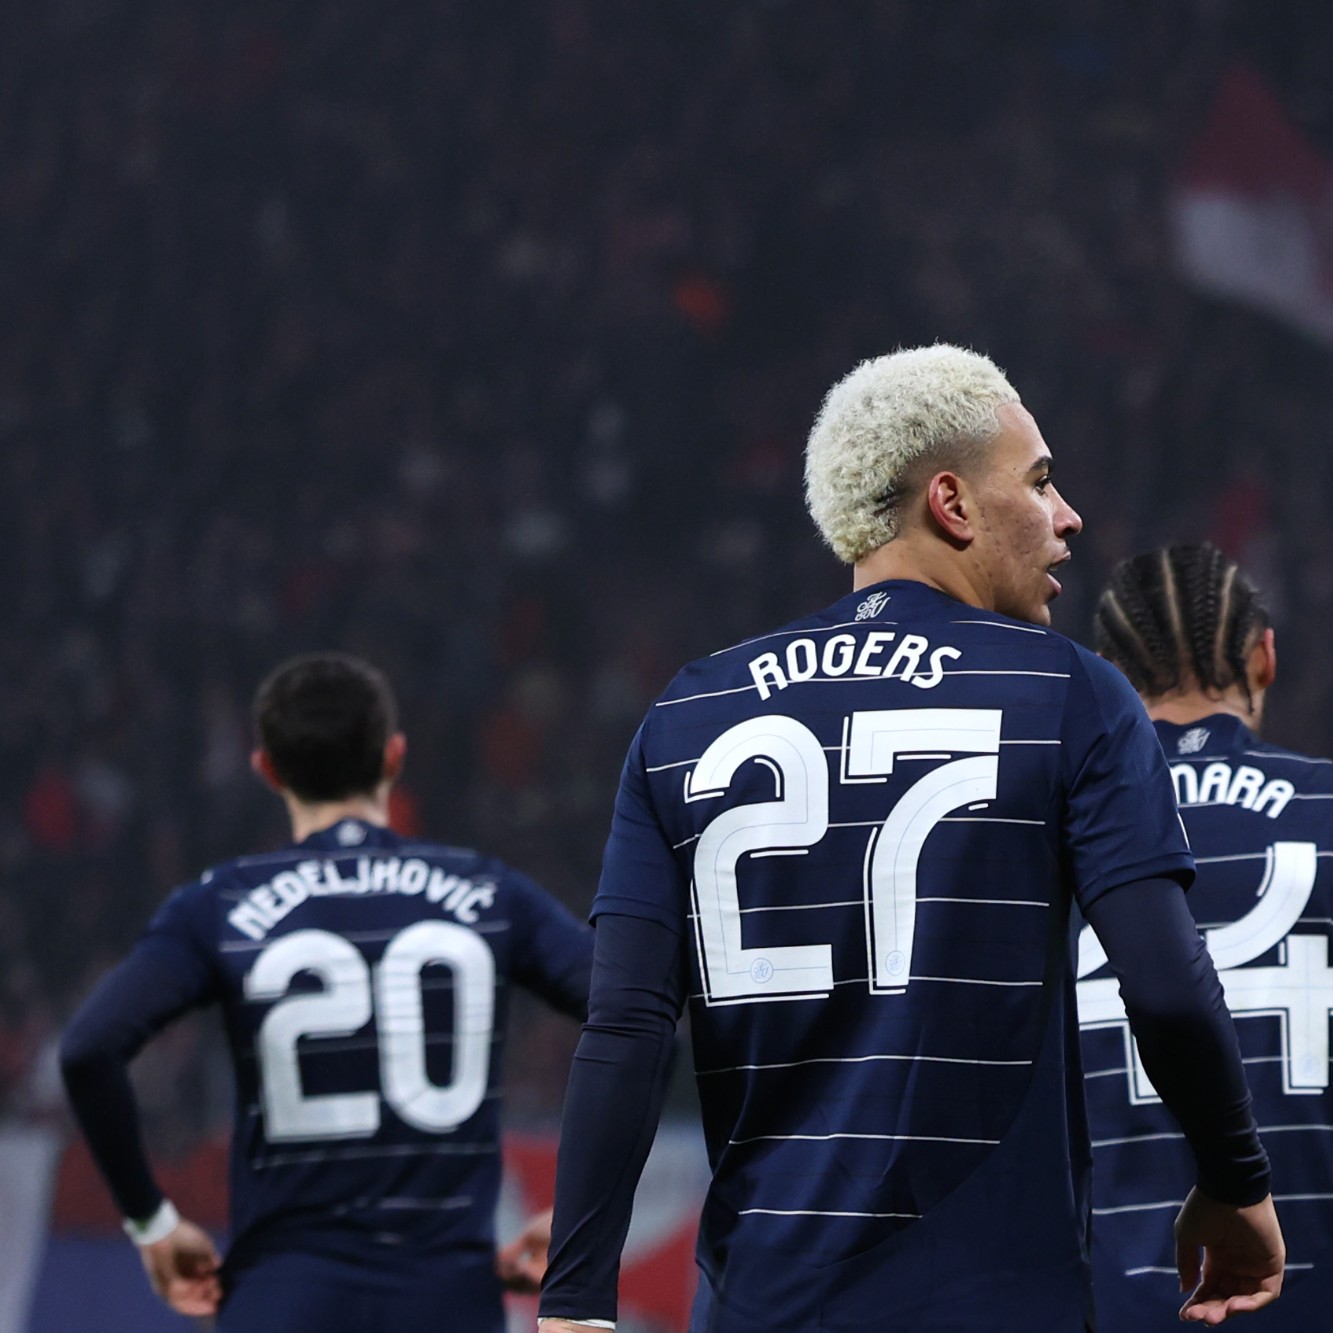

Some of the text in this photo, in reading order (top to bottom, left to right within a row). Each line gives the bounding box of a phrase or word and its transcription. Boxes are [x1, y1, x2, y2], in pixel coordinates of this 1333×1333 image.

[748, 631, 961, 700] ROGERS
[227, 856, 497, 940] NEDELJKOVIĆ
[684, 708, 1003, 1007] 27
[243, 919, 497, 1143] 20
